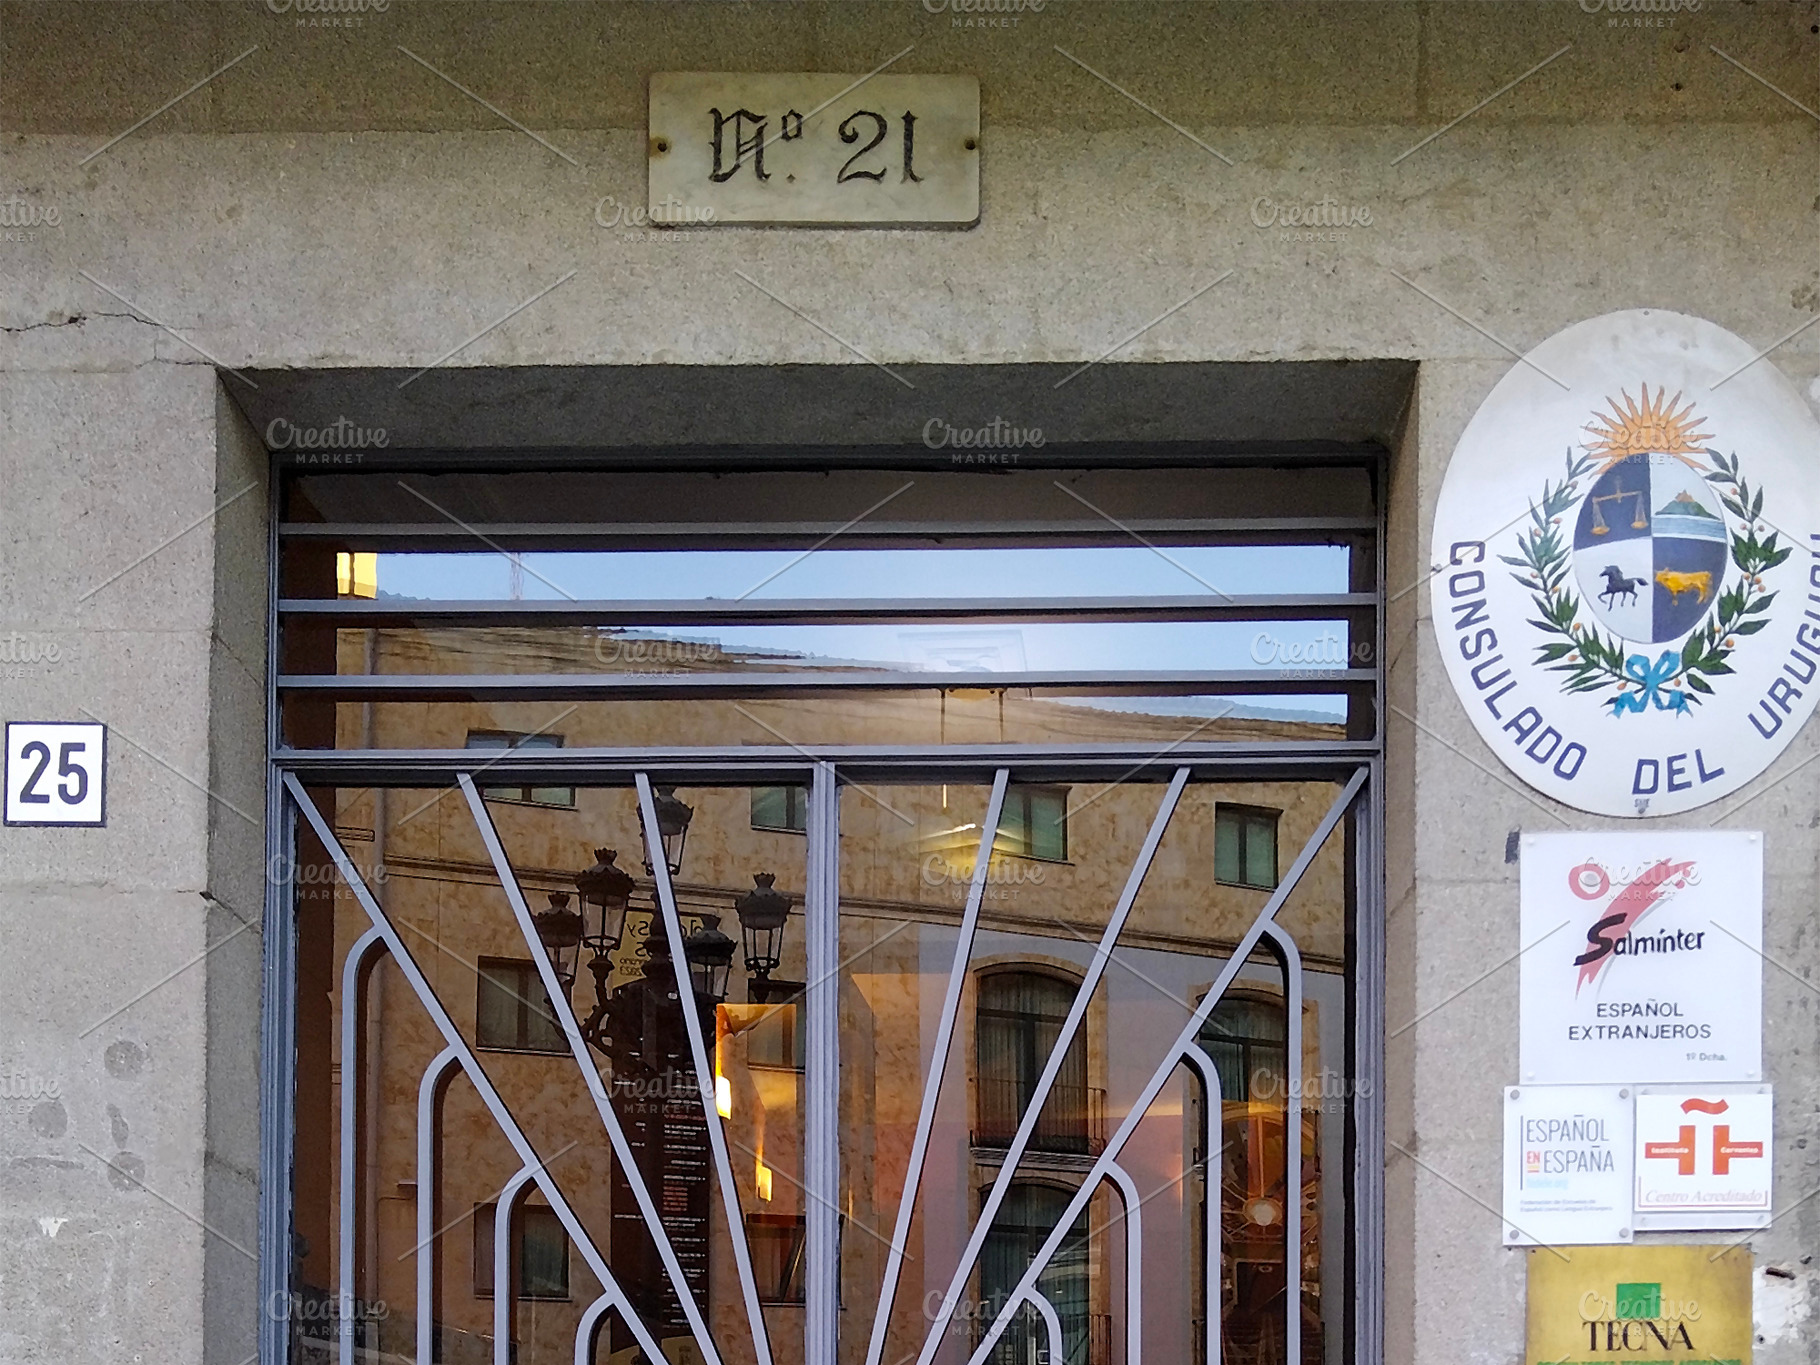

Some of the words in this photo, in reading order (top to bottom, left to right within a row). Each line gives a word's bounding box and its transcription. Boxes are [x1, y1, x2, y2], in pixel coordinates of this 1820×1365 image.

[837, 110, 924, 184] 21
[1448, 541, 1588, 782] CONSULADO
[1631, 748, 1725, 795] DEL
[19, 740, 90, 805] 25
[1596, 998, 1684, 1018] ESPAÑOL
[1568, 1023, 1712, 1041] EXTRANJEROS
[1526, 1114, 1610, 1142] ESPAÑOL
[1526, 1151, 1541, 1164] EN
[1543, 1145, 1615, 1173] ESPAÑA
[1645, 1189, 1689, 1202] Centro
[1692, 1189, 1763, 1202] Acreditado
[1582, 1320, 1696, 1351] TECNA
